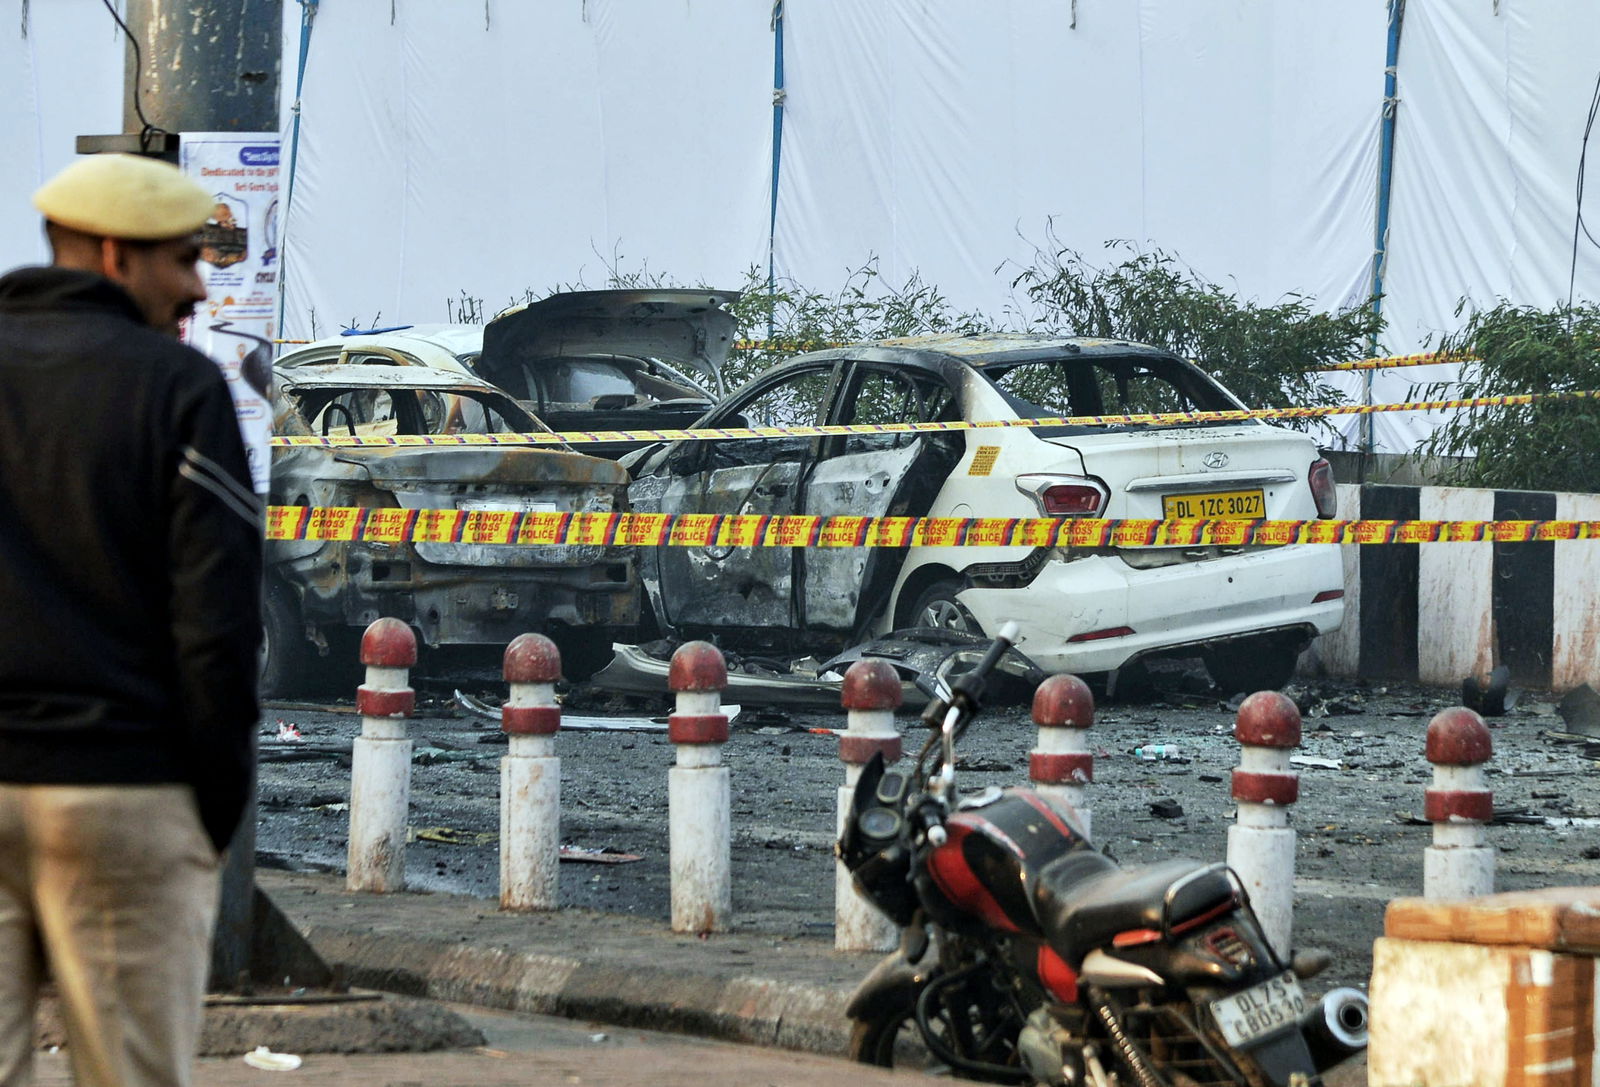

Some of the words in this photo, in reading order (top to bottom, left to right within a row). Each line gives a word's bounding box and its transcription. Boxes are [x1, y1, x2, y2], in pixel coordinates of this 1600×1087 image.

[1177, 501, 1195, 518] DL
[1200, 499, 1224, 516] 1ZC
[1228, 496, 1260, 514] 3027
[312, 510, 326, 518] DO
[329, 510, 350, 518] NOT
[372, 514, 401, 523] DELHI
[468, 513, 482, 521] DO
[485, 514, 505, 522] NOT
[312, 520, 345, 528] CROSS
[526, 517, 554, 526] DELHI
[638, 516, 657, 524] NOT
[677, 519, 705, 528] DELHI
[787, 518, 806, 526] NOT
[468, 523, 500, 531] CROSS
[621, 525, 652, 533] CROSS
[918, 527, 948, 535] CROSS
[1063, 527, 1092, 535] CROSS
[1206, 527, 1236, 535] CROSS
[316, 529, 338, 538] LINE
[365, 527, 400, 537] POLICE
[472, 532, 493, 541] LINE
[520, 530, 554, 539] POLICE
[672, 531, 705, 541] POLICE
[1256, 532, 1287, 541] POLICE
[624, 534, 645, 543] LINE
[774, 536, 794, 544] LINE
[821, 533, 854, 542] POLICE
[922, 536, 942, 545] LINE
[968, 533, 1000, 542] POLICE
[1067, 536, 1087, 545] LINE
[1112, 532, 1145, 542] POLICE
